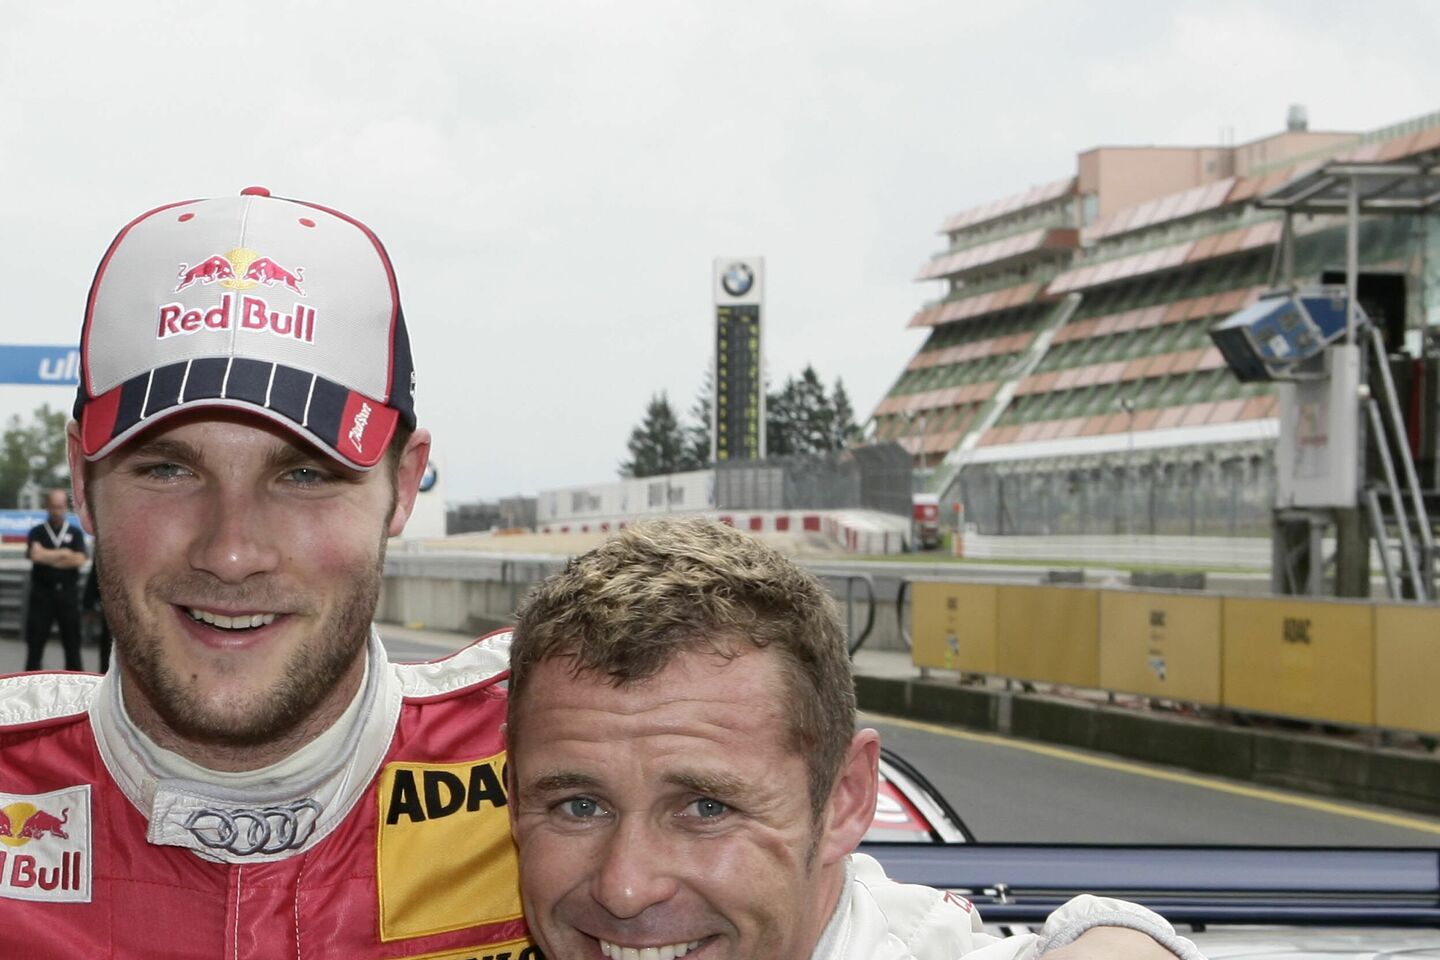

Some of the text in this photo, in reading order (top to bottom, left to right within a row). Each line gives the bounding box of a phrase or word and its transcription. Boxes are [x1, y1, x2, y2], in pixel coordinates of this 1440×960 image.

[157, 294, 316, 342] Red Bull
[386, 762, 508, 825] ADA
[10, 851, 81, 891] Bull
